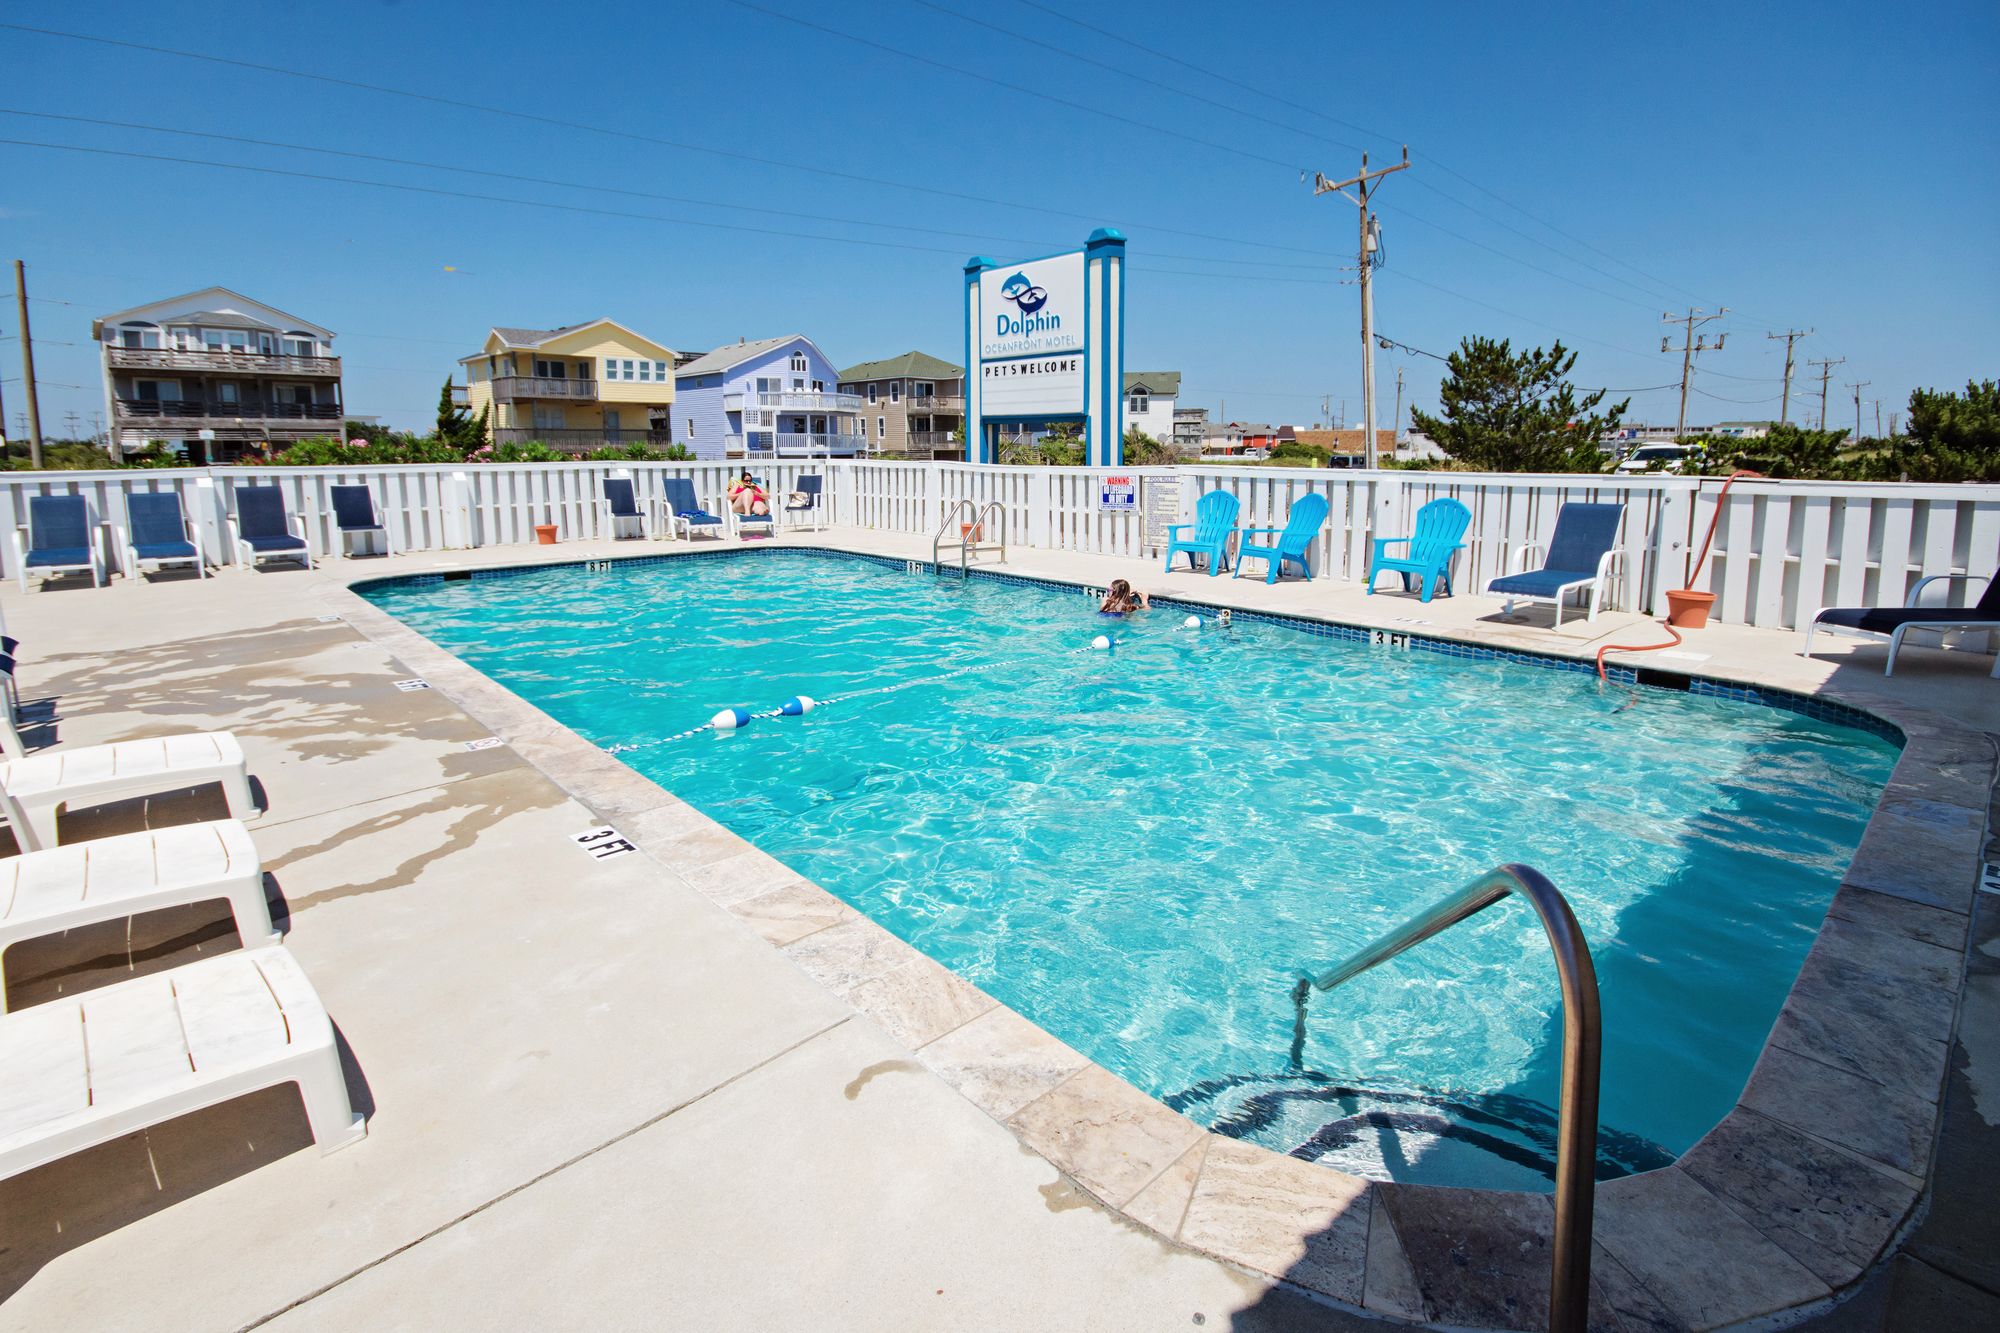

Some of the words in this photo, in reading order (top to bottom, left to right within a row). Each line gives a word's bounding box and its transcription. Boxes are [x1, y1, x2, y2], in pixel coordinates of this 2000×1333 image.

[997, 310, 1060, 338] Dolphin
[985, 339, 1041, 354] OCEANFRONT
[1045, 334, 1076, 348] MOTEL
[1106, 476, 1130, 486] WARNING
[600, 560, 610, 572] FT
[1096, 589, 1107, 599] FT
[1376, 631, 1384, 645] 3
[1391, 632, 1408, 648] FT
[577, 830, 614, 843] 3
[587, 838, 637, 859] FT
